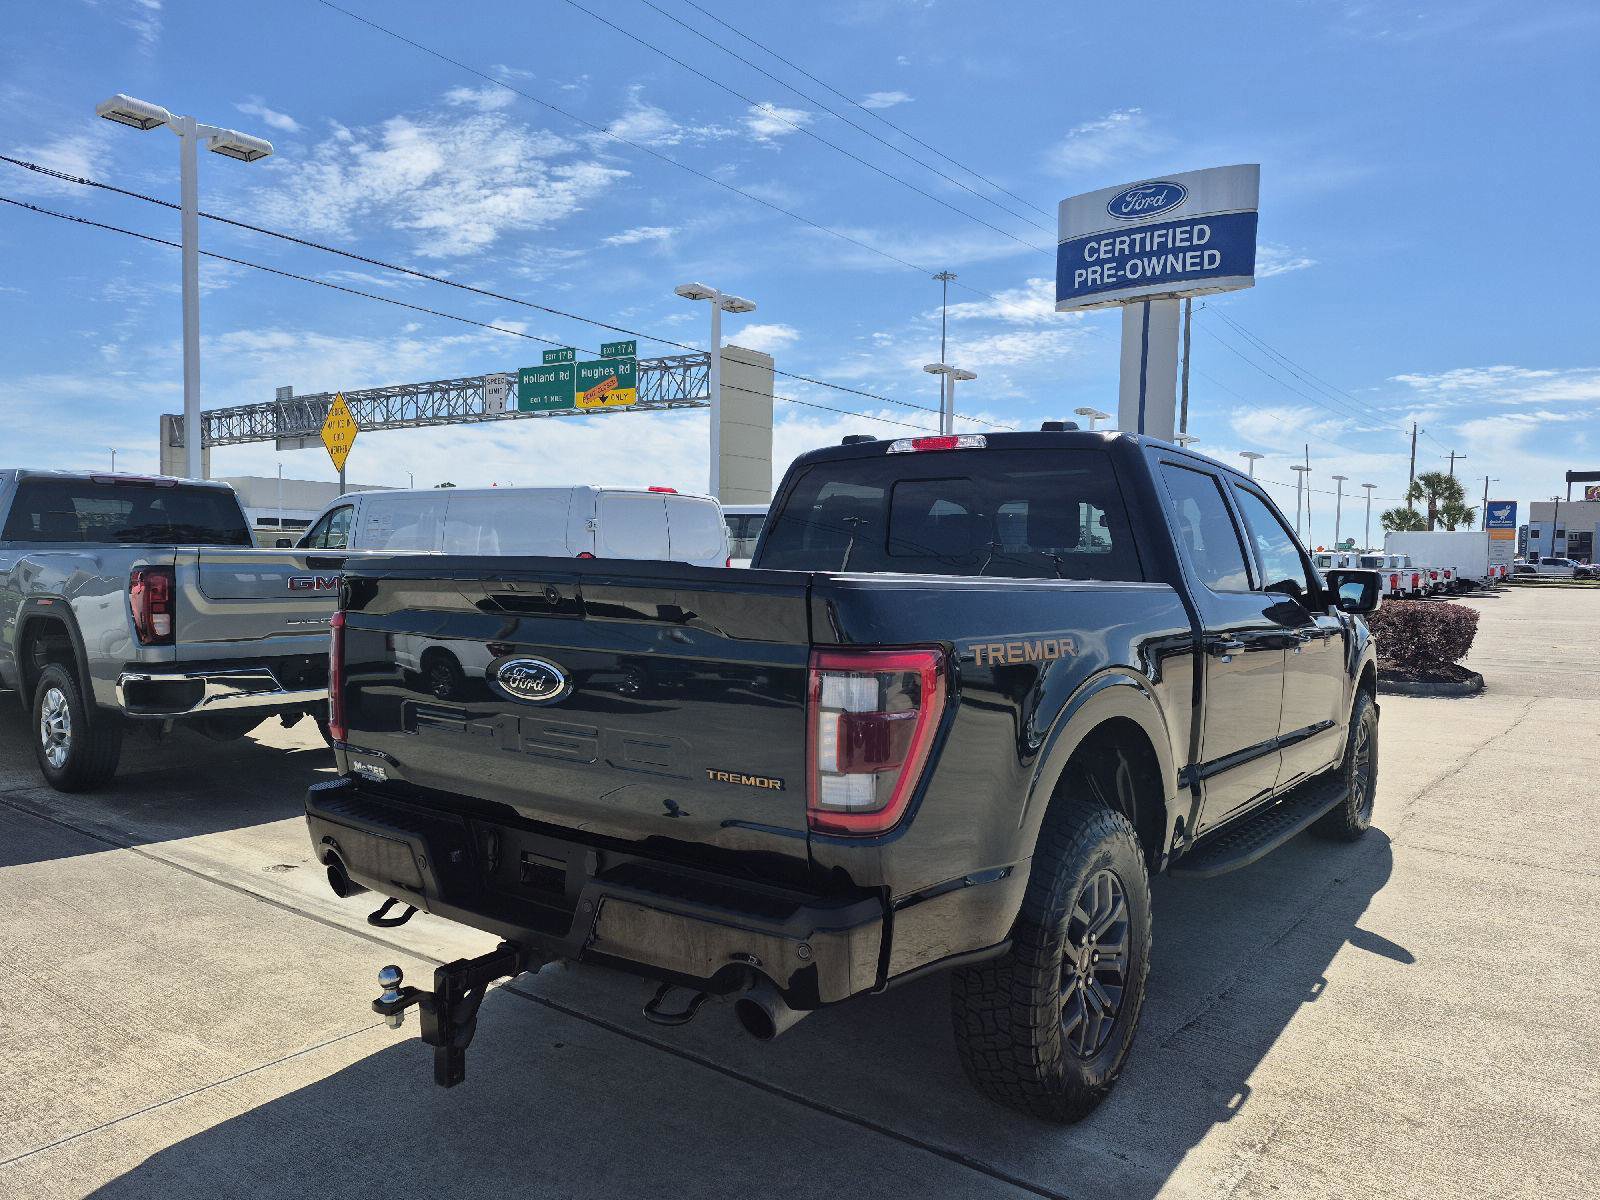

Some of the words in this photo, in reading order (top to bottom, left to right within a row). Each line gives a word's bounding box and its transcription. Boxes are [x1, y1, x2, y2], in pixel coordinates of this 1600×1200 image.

[1121, 187, 1167, 213] Ford
[1084, 224, 1211, 262] CERTIFIED
[1074, 249, 1222, 289] PRE-OWNED
[486, 377, 505, 386] SPEED
[523, 372, 555, 384] Holland
[559, 371, 570, 381] Rd
[581, 365, 615, 379] Hughes
[618, 364, 630, 374] Rd
[611, 393, 629, 401] ONLY
[288, 575, 342, 591] GM
[968, 639, 1077, 666] TREMOR
[506, 667, 546, 691] Ford
[706, 768, 782, 790] TREMOR
